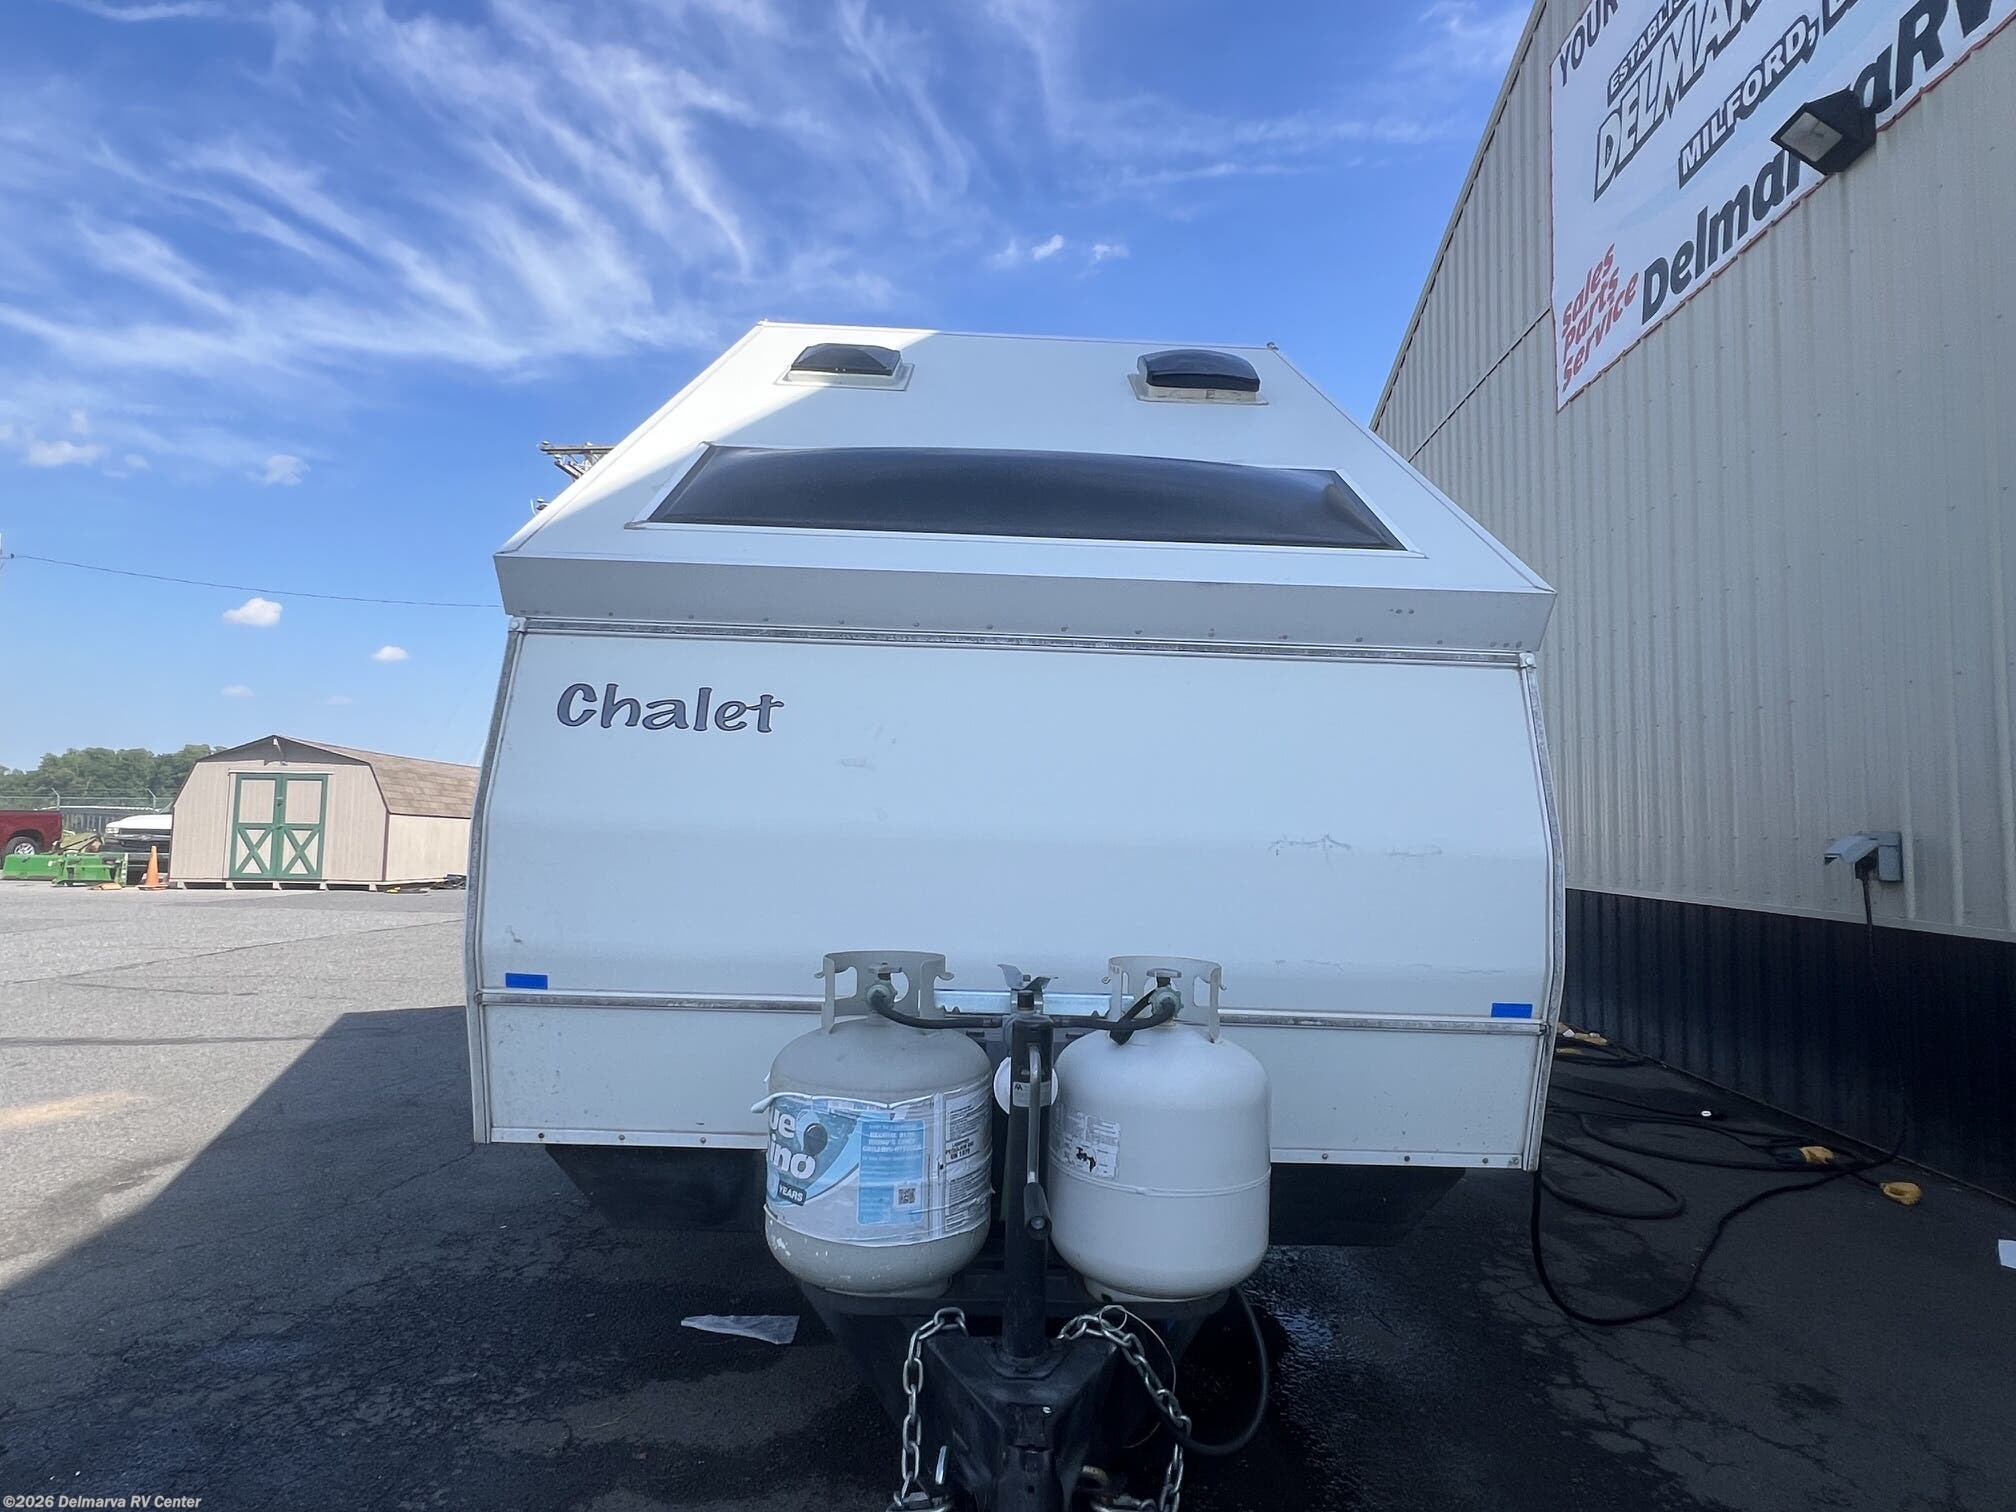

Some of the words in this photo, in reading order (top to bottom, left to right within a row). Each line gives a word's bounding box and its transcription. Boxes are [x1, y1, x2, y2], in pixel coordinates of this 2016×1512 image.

[1678, 14, 1819, 188] MILFORD,
[1562, 243, 1615, 339] sales
[1563, 267, 1620, 364] parts
[1563, 272, 1639, 393] service
[556, 683, 785, 733] Chalet
[779, 1184, 804, 1203] YEARS
